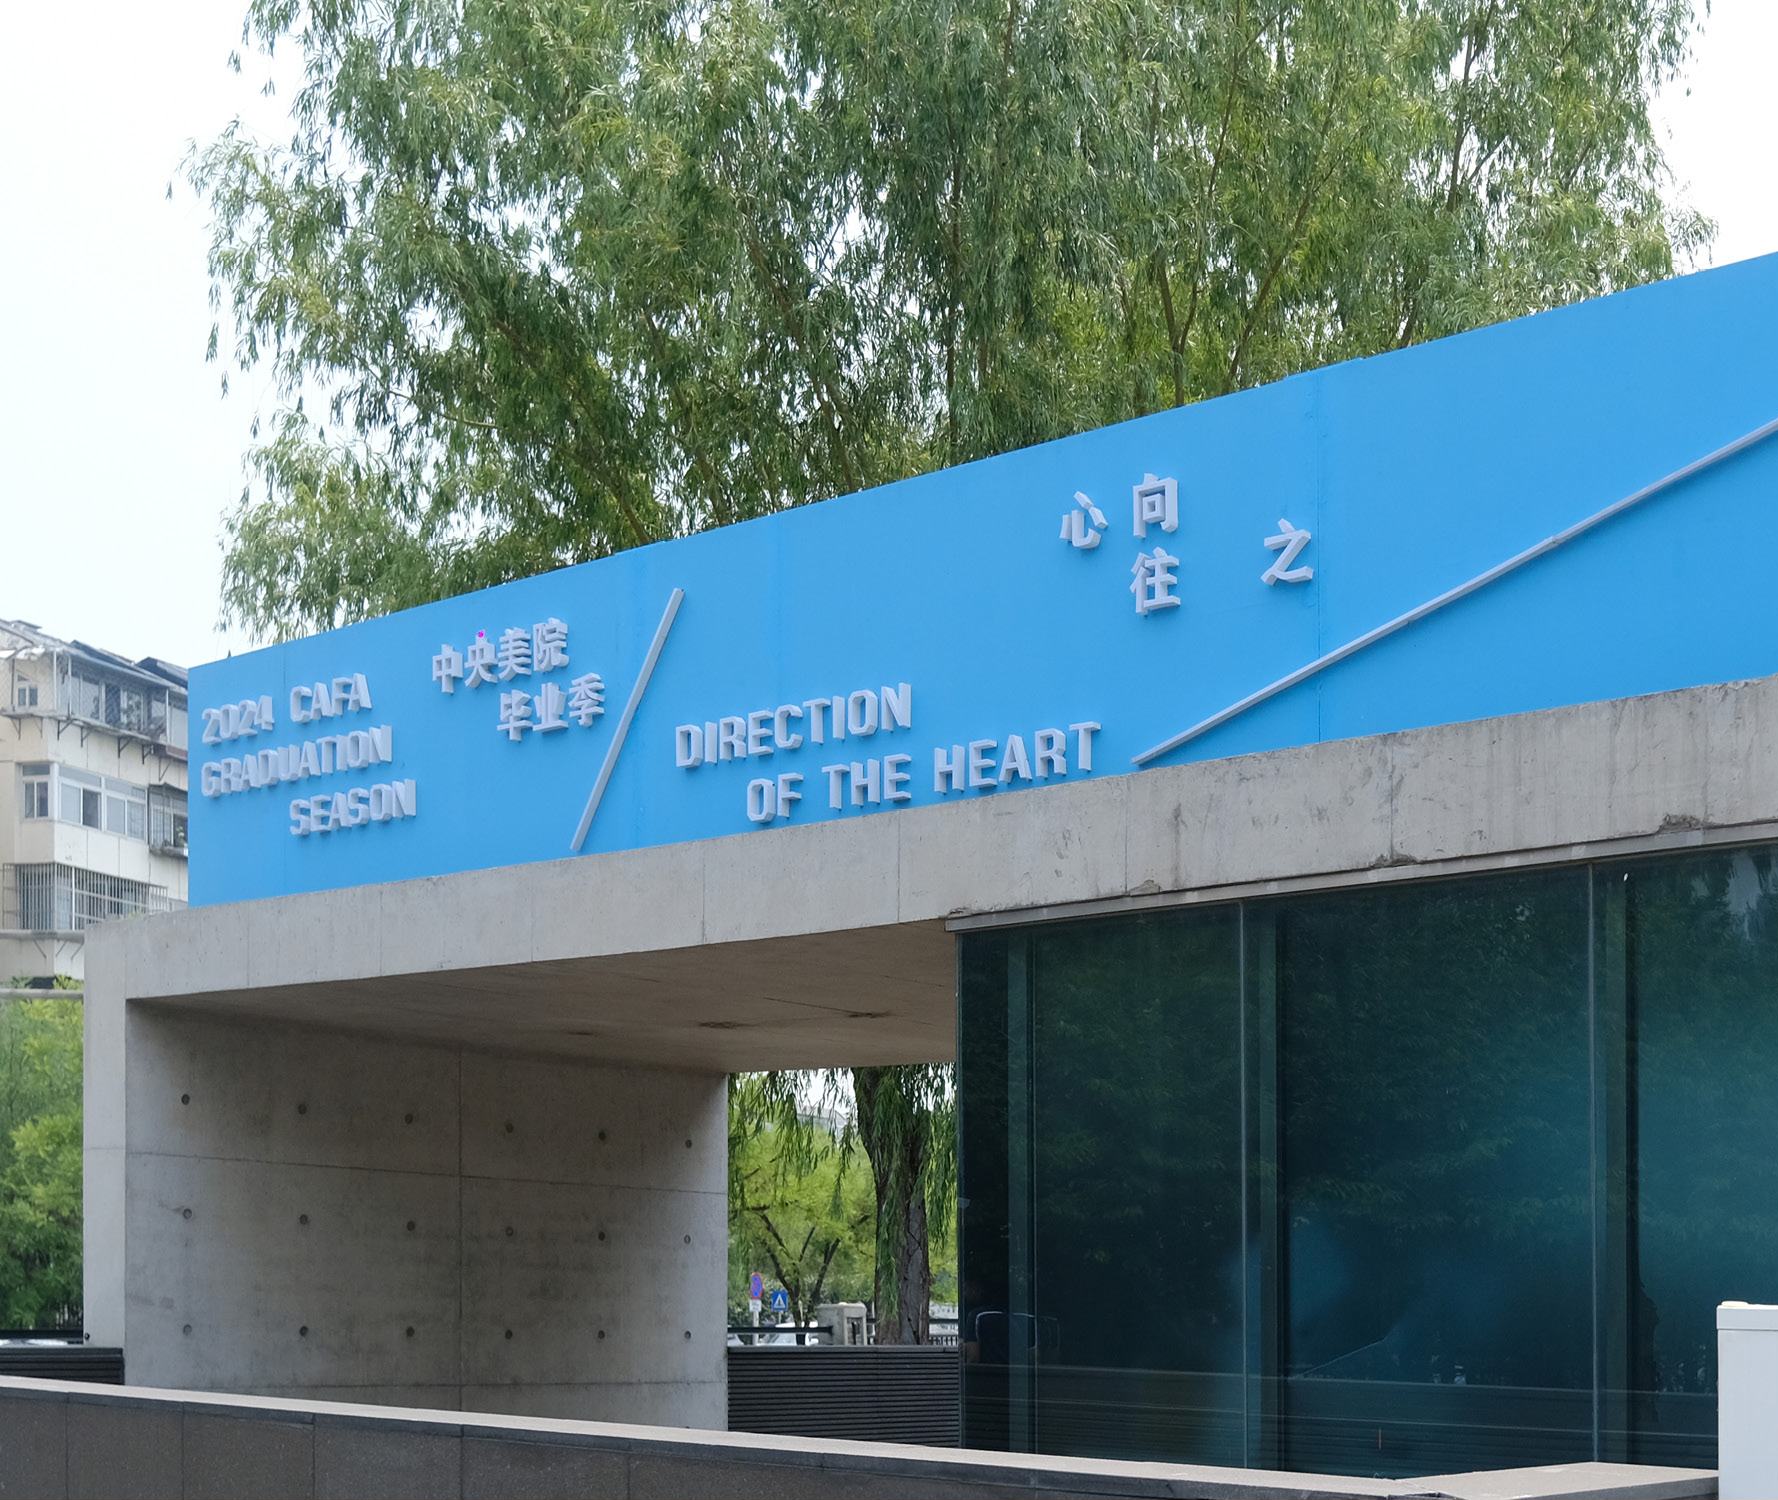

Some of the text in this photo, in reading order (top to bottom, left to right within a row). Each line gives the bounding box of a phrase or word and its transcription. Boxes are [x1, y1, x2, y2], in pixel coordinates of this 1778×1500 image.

[432, 617, 570, 694] 中央美院
[202, 673, 373, 745] 2024 CAFA
[497, 672, 605, 742] 毕业季
[675, 682, 912, 769] DIRECTION
[201, 725, 393, 798] GRADUATION
[746, 720, 1101, 823] OF THE HEART
[289, 778, 416, 836] SEASON
